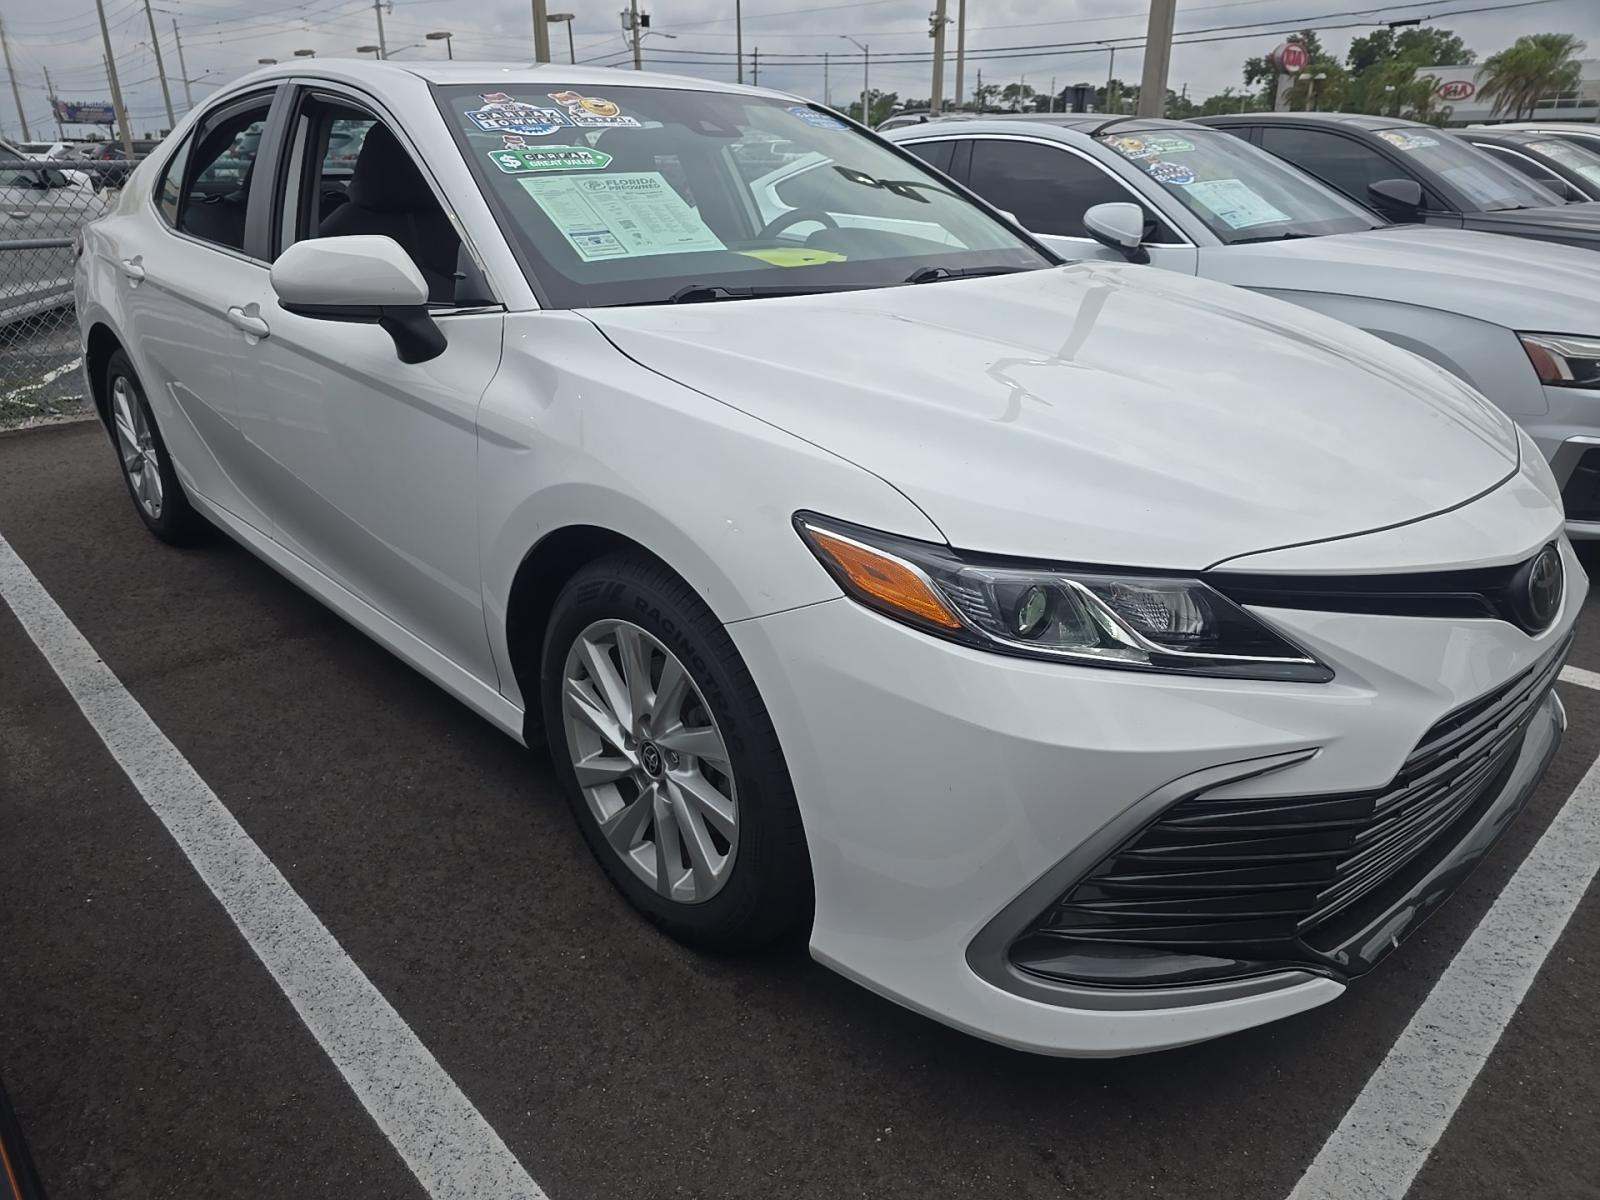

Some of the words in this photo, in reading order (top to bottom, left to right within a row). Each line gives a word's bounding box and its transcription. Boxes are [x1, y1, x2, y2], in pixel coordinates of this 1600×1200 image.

[475, 109, 561, 120] CARFAX
[498, 116, 566, 127] OWNER
[523, 151, 593, 161] CARFAX
[529, 159, 563, 168] GREAT
[563, 158, 597, 167] VALUE
[605, 177, 658, 186] FLORIDA
[608, 183, 661, 191] PREOWNED
